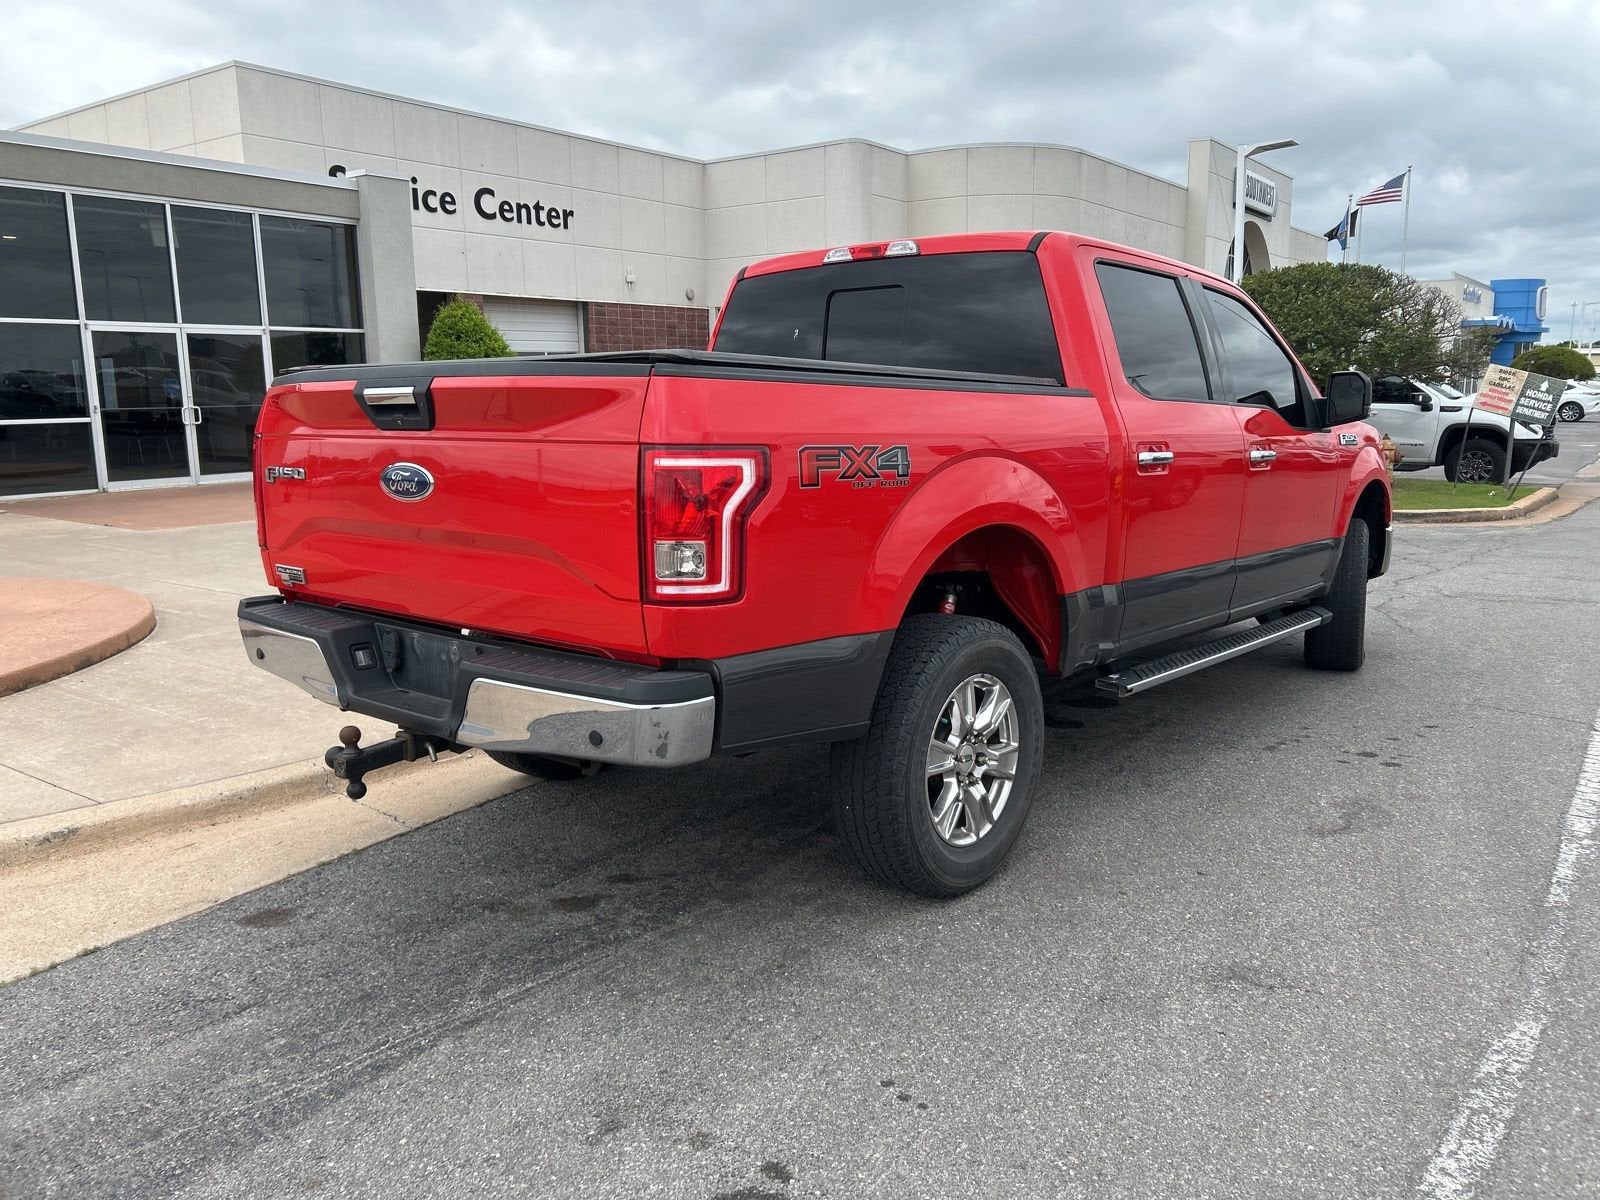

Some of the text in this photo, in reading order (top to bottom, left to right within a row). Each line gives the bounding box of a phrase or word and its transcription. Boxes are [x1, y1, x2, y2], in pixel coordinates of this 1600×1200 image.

[473, 187, 575, 230] Center
[1519, 397, 1554, 411] SERVICE
[1525, 388, 1554, 402] HONDA
[1515, 406, 1550, 420] DEPARTMENT
[798, 445, 911, 488] FX4
[390, 470, 418, 492] Ford
